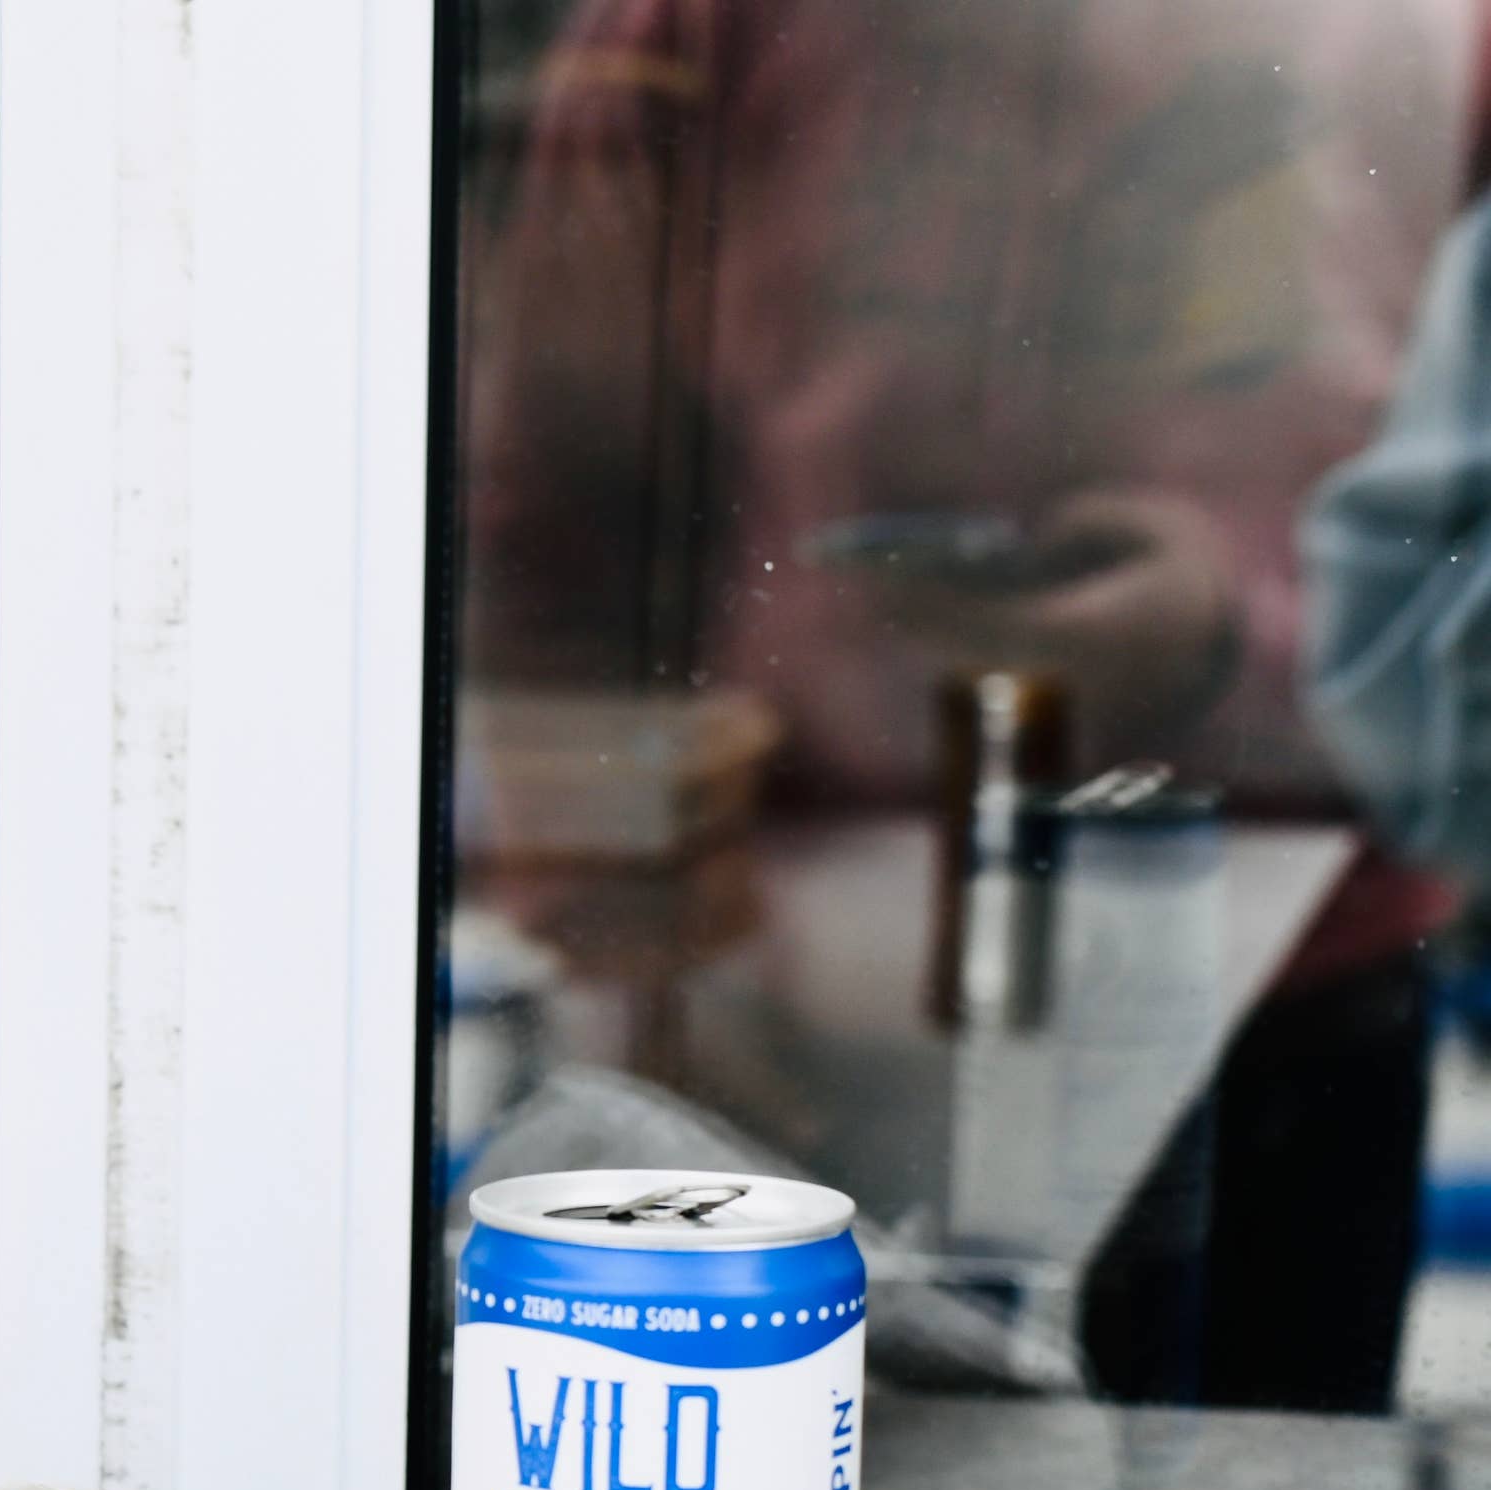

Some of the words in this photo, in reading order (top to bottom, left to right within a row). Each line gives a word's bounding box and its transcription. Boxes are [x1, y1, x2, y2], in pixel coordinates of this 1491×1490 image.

[521, 1295, 564, 1323] ZERO
[571, 1302, 638, 1330] SUGAR
[644, 1307, 700, 1332] SODA
